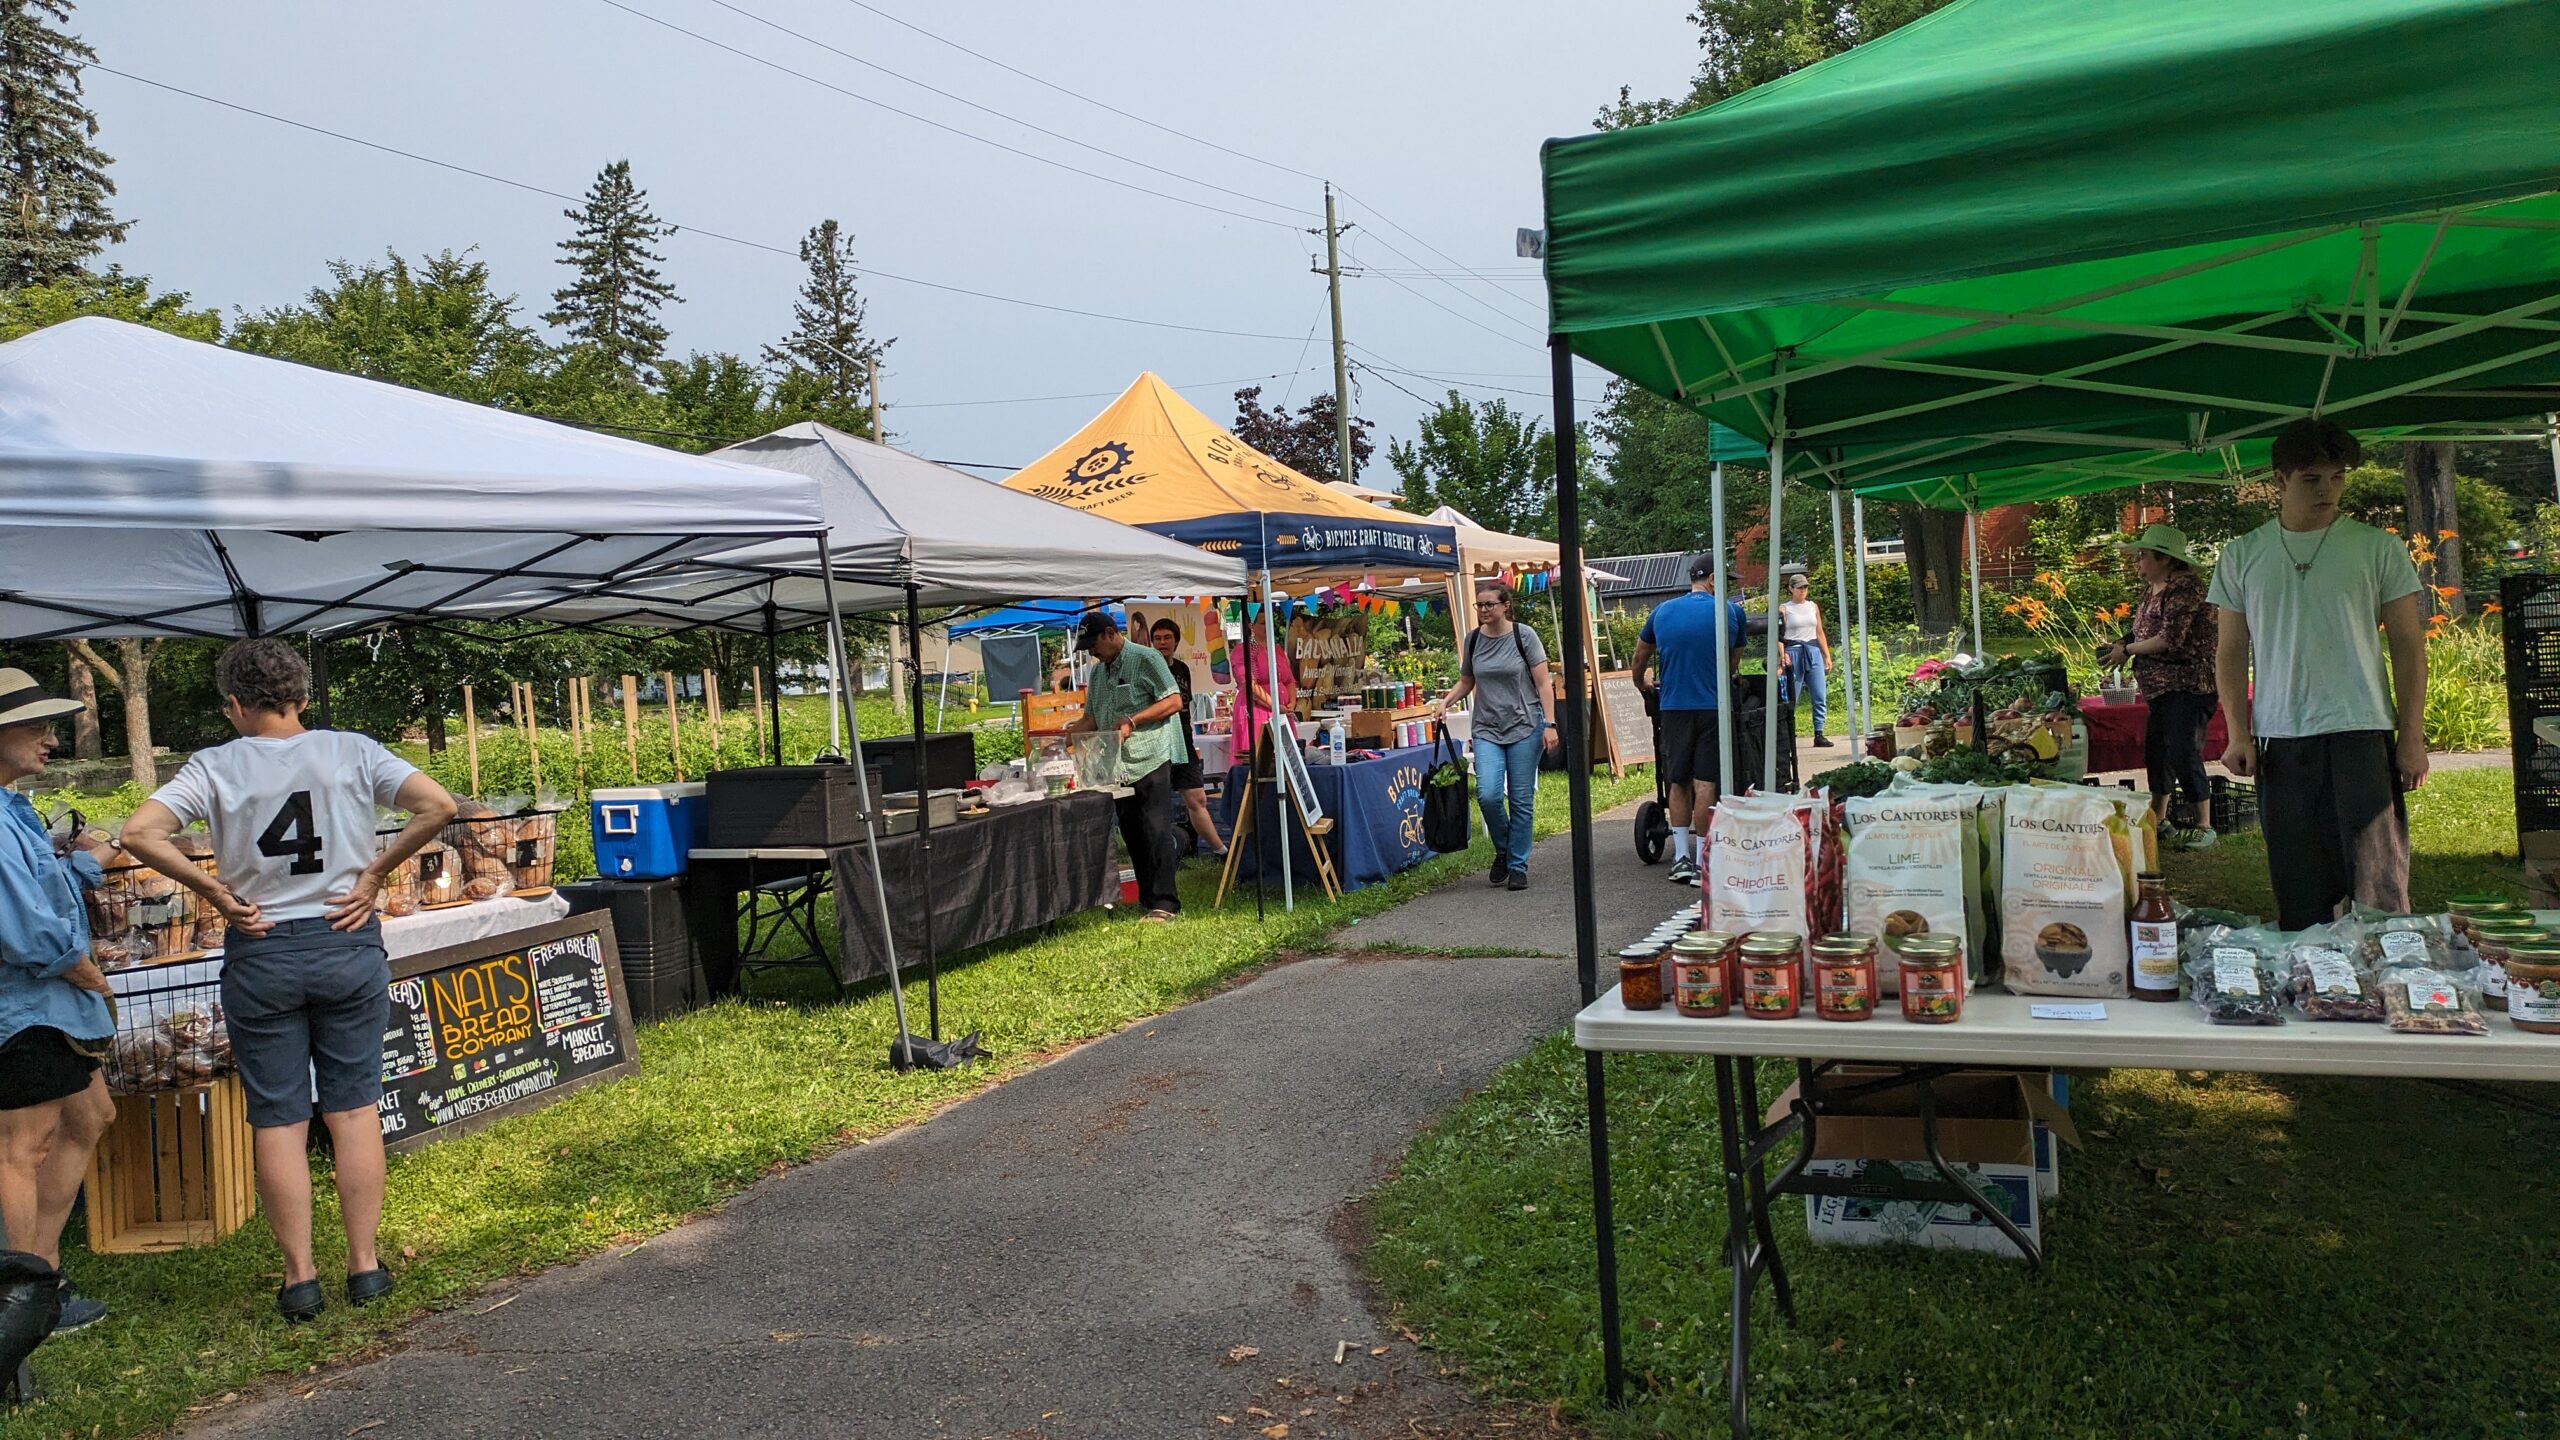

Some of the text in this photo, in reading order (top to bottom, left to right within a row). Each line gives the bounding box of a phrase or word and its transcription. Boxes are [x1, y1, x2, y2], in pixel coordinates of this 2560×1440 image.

[1076, 490, 1135, 511] RAFT BEER
[1325, 529, 1415, 551] BICYCLE CRAFT BREWERY
[1388, 766, 1422, 803] BICYCL
[1851, 812, 1876, 824] LOS
[1881, 809, 1958, 822] CANTORES
[2010, 816, 2104, 835] LOS CANTORES
[257, 791, 323, 875] 4
[1715, 831, 1736, 847] LOS
[1741, 831, 1801, 850] CANTORES
[1889, 853, 1920, 864] LIME
[2033, 863, 2095, 876] ORIGINAL
[1727, 874, 1786, 889] CHIPOTLE
[2033, 879, 2096, 891] ORIGINALE
[532, 936, 601, 980] FRESH BREAD
[432, 956, 529, 1024] NAT'S
[442, 1004, 531, 1044] BREAD
[446, 1023, 532, 1059] COMPANY
[562, 1022, 604, 1050] MARKET
[572, 1040, 615, 1064] SPECIALS
[445, 1085, 467, 1103] HOME
[467, 1074, 497, 1094] DELIVERY
[498, 1058, 542, 1083] SUBSCRIPTIONS
[379, 1089, 400, 1112] KET
[382, 1112, 407, 1134] IALS
